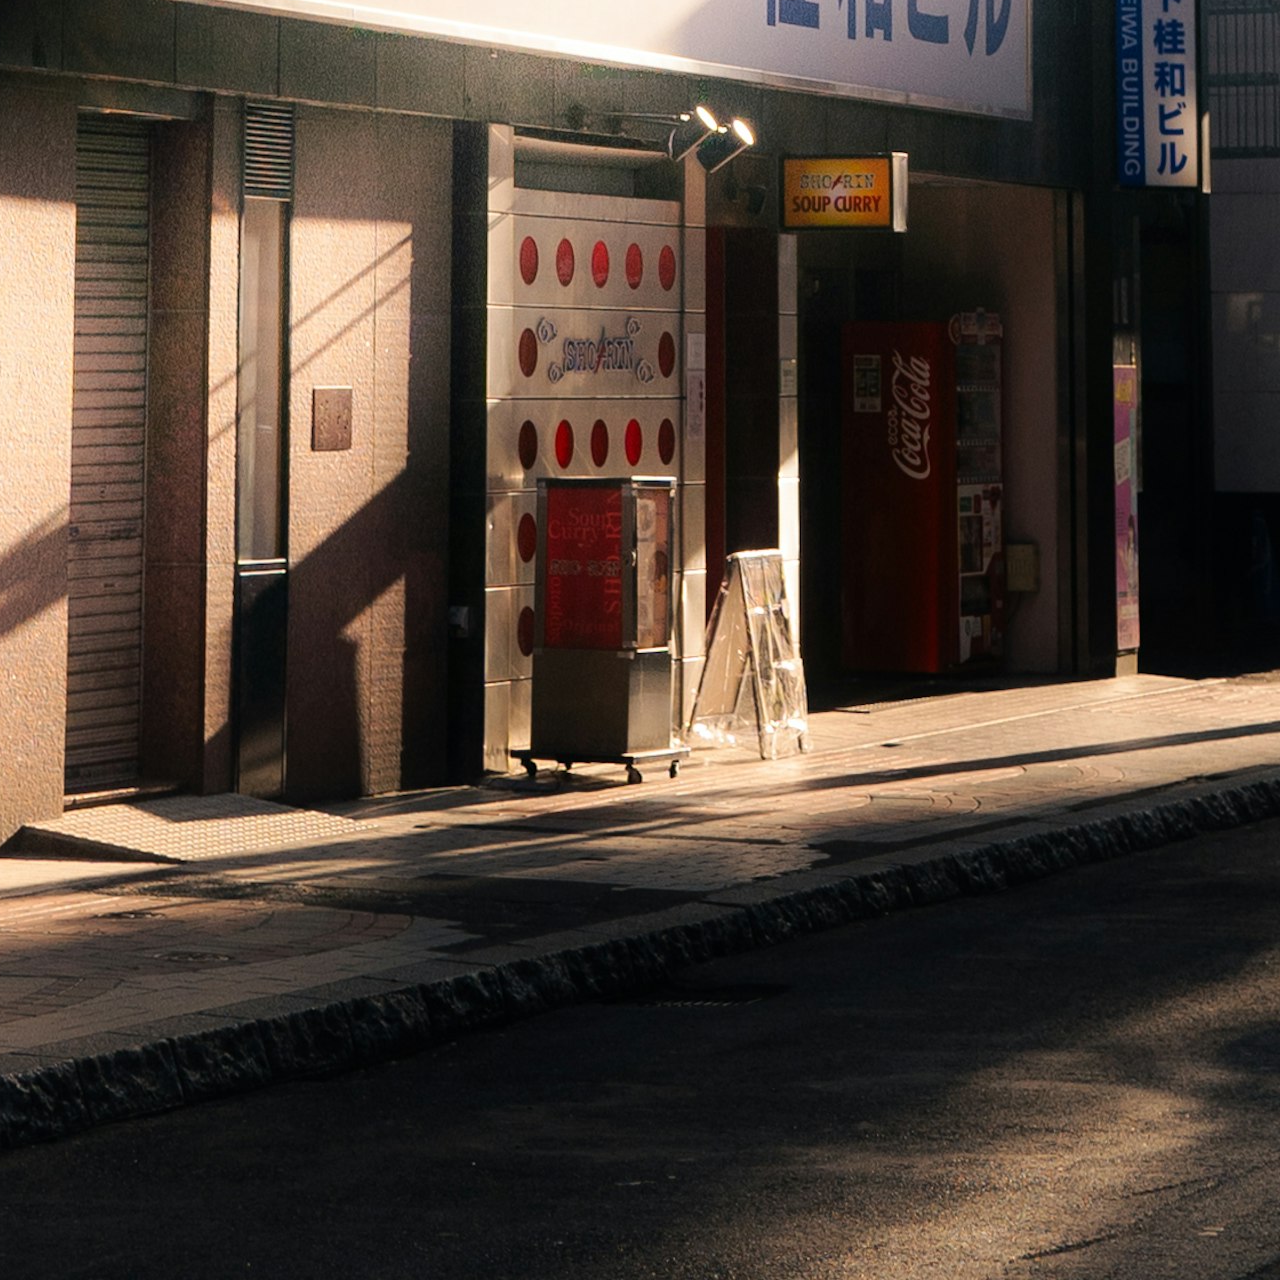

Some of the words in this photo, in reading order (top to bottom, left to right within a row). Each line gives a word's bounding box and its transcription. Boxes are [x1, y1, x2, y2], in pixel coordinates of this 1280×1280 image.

[1121, 58, 1143, 178] BUILDING
[792, 195, 831, 213] SOUP
[834, 195, 882, 213] CURRY
